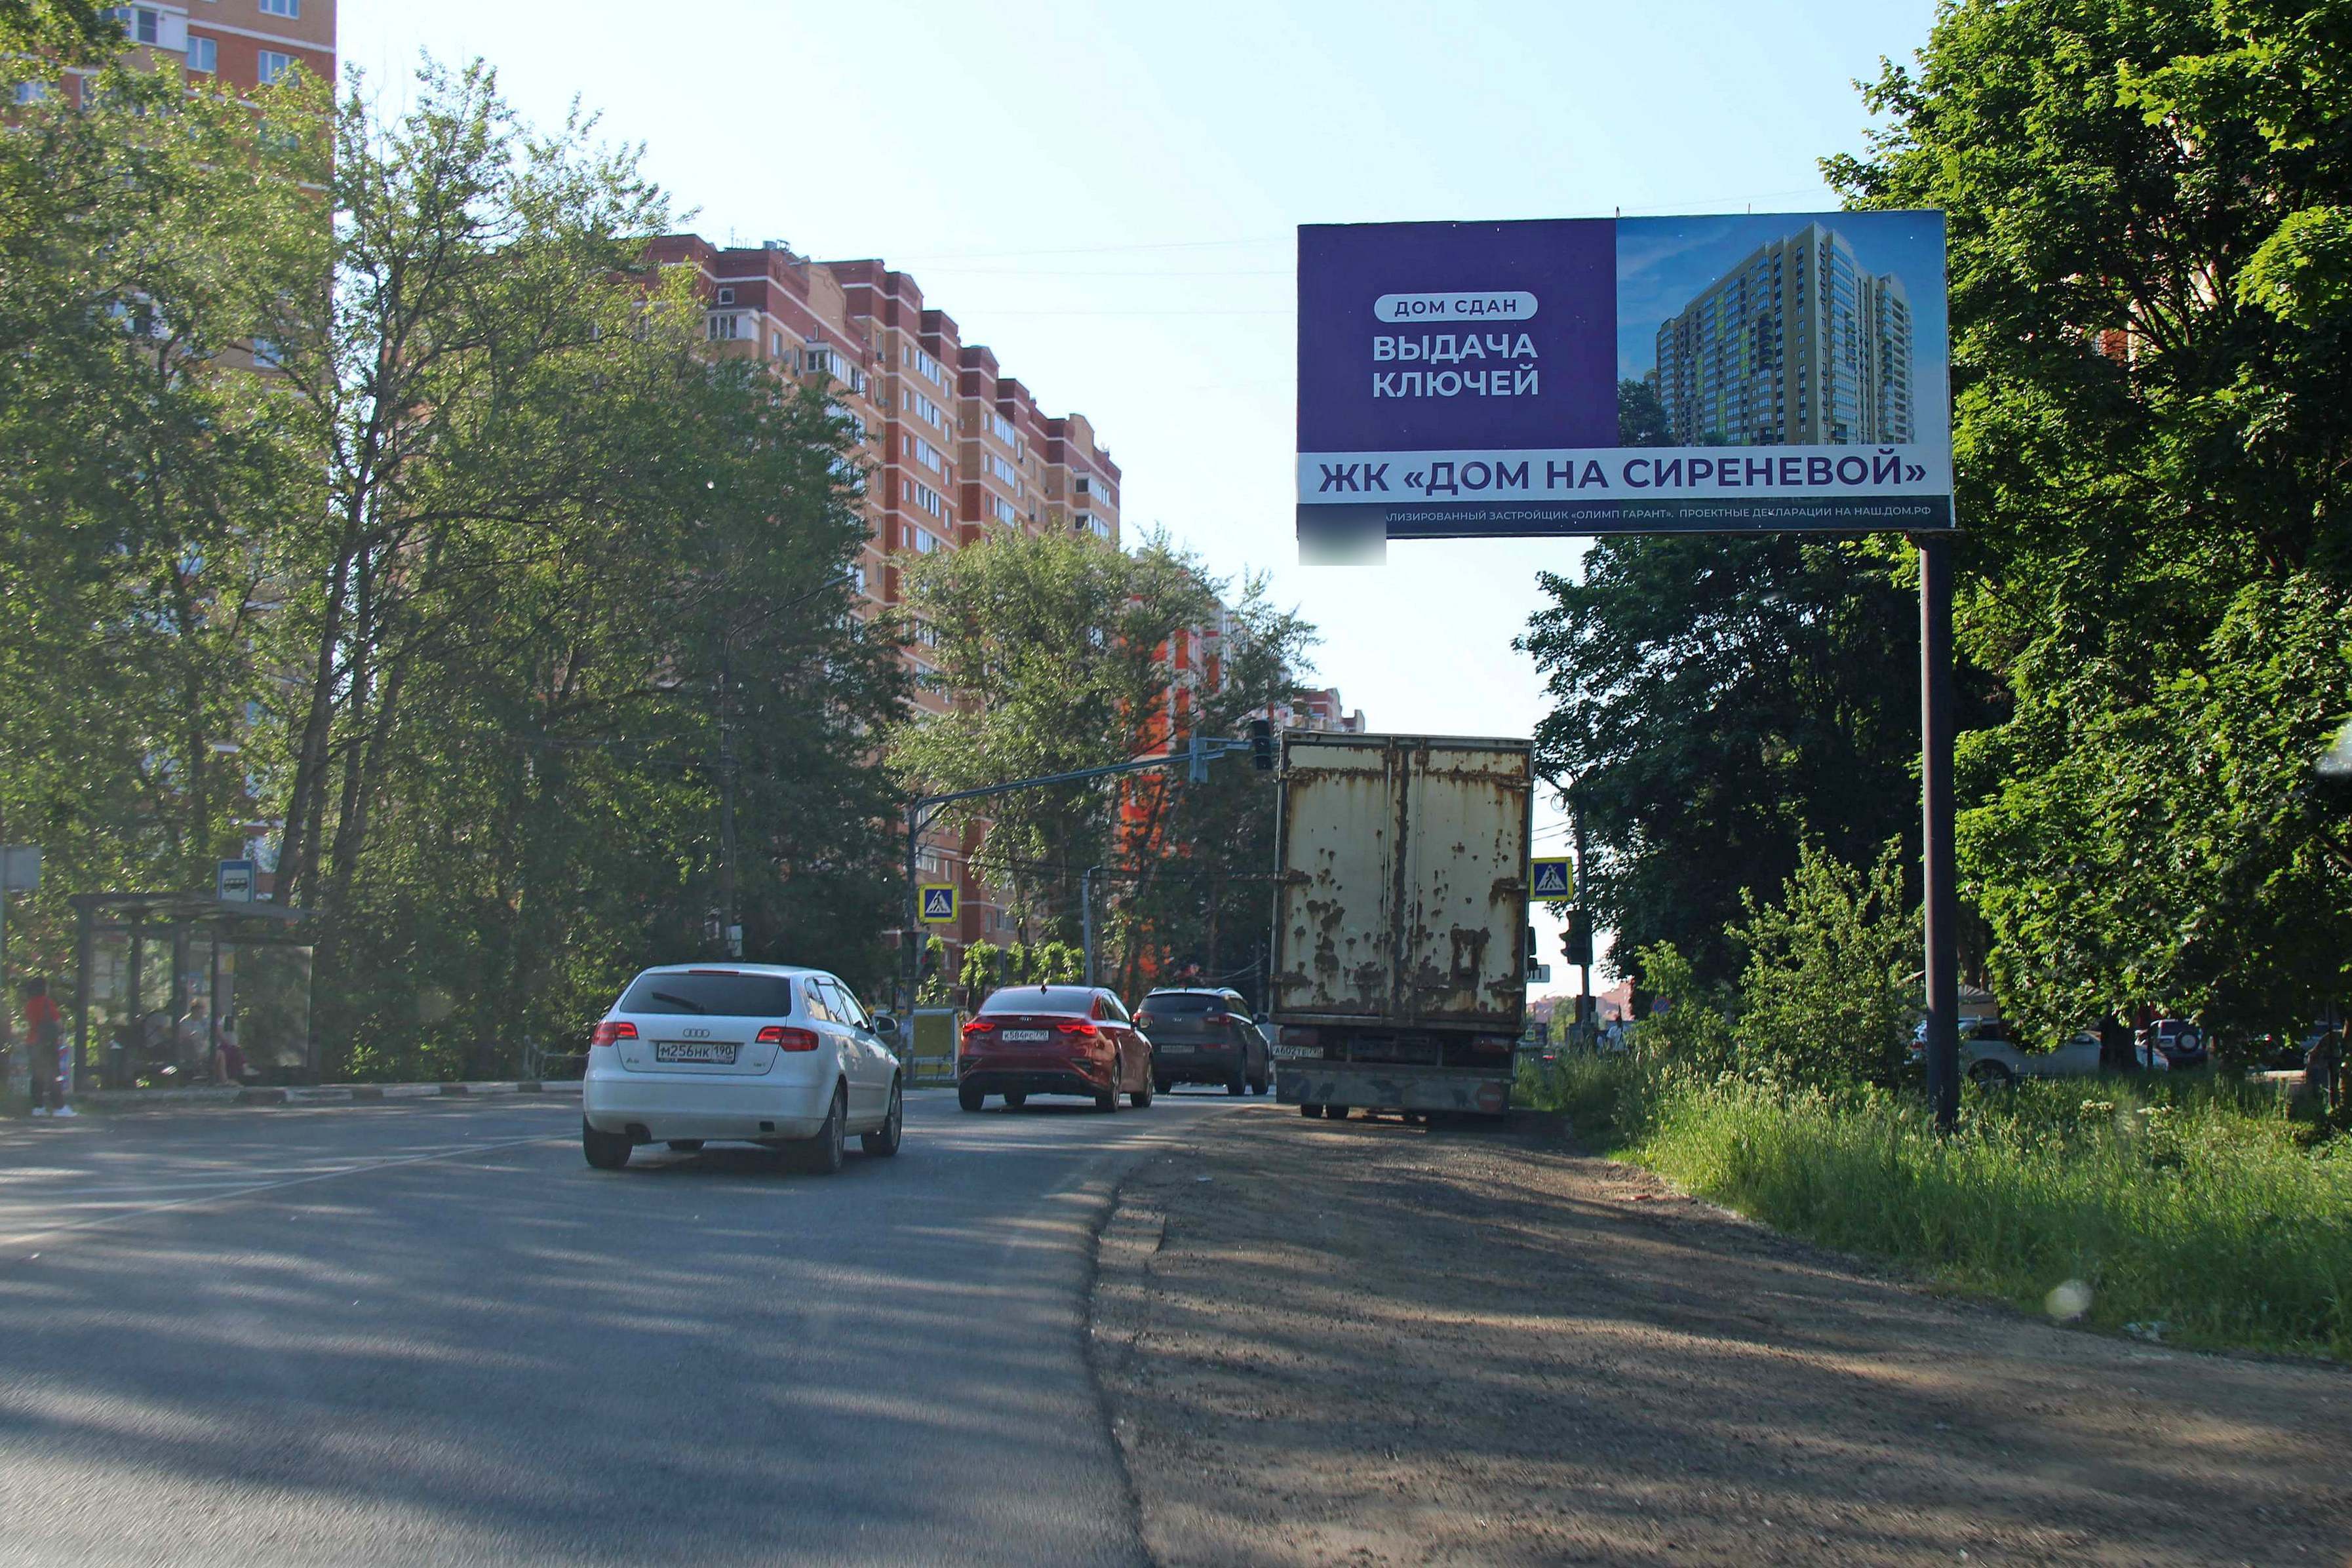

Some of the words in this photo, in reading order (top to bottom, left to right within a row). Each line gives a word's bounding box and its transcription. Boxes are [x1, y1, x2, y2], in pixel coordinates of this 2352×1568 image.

[1394, 300, 1445, 317] ДОМ
[1455, 299, 1517, 315] СДАН
[1373, 333, 1539, 364] ВЫДАЧА
[1373, 363, 1539, 398] КЛЮЧЕЙ
[1318, 462, 1390, 492] ЖК
[1403, 460, 1529, 496] «ДОМ
[1546, 460, 1609, 490] НА
[1622, 448, 1927, 488] СИРЕНЕВОЙ»
[1489, 509, 1569, 520] ЗАСТРОЙЩИК
[1571, 510, 1620, 519] «ОЛИМП
[1679, 508, 1750, 518] ПРОЕКТНЫЕ
[1752, 507, 1832, 519] ДЕКЛАРАЦИИ
[1835, 507, 1852, 517] НА
[1854, 506, 1931, 517] НАШ.ДОМ.РФ
